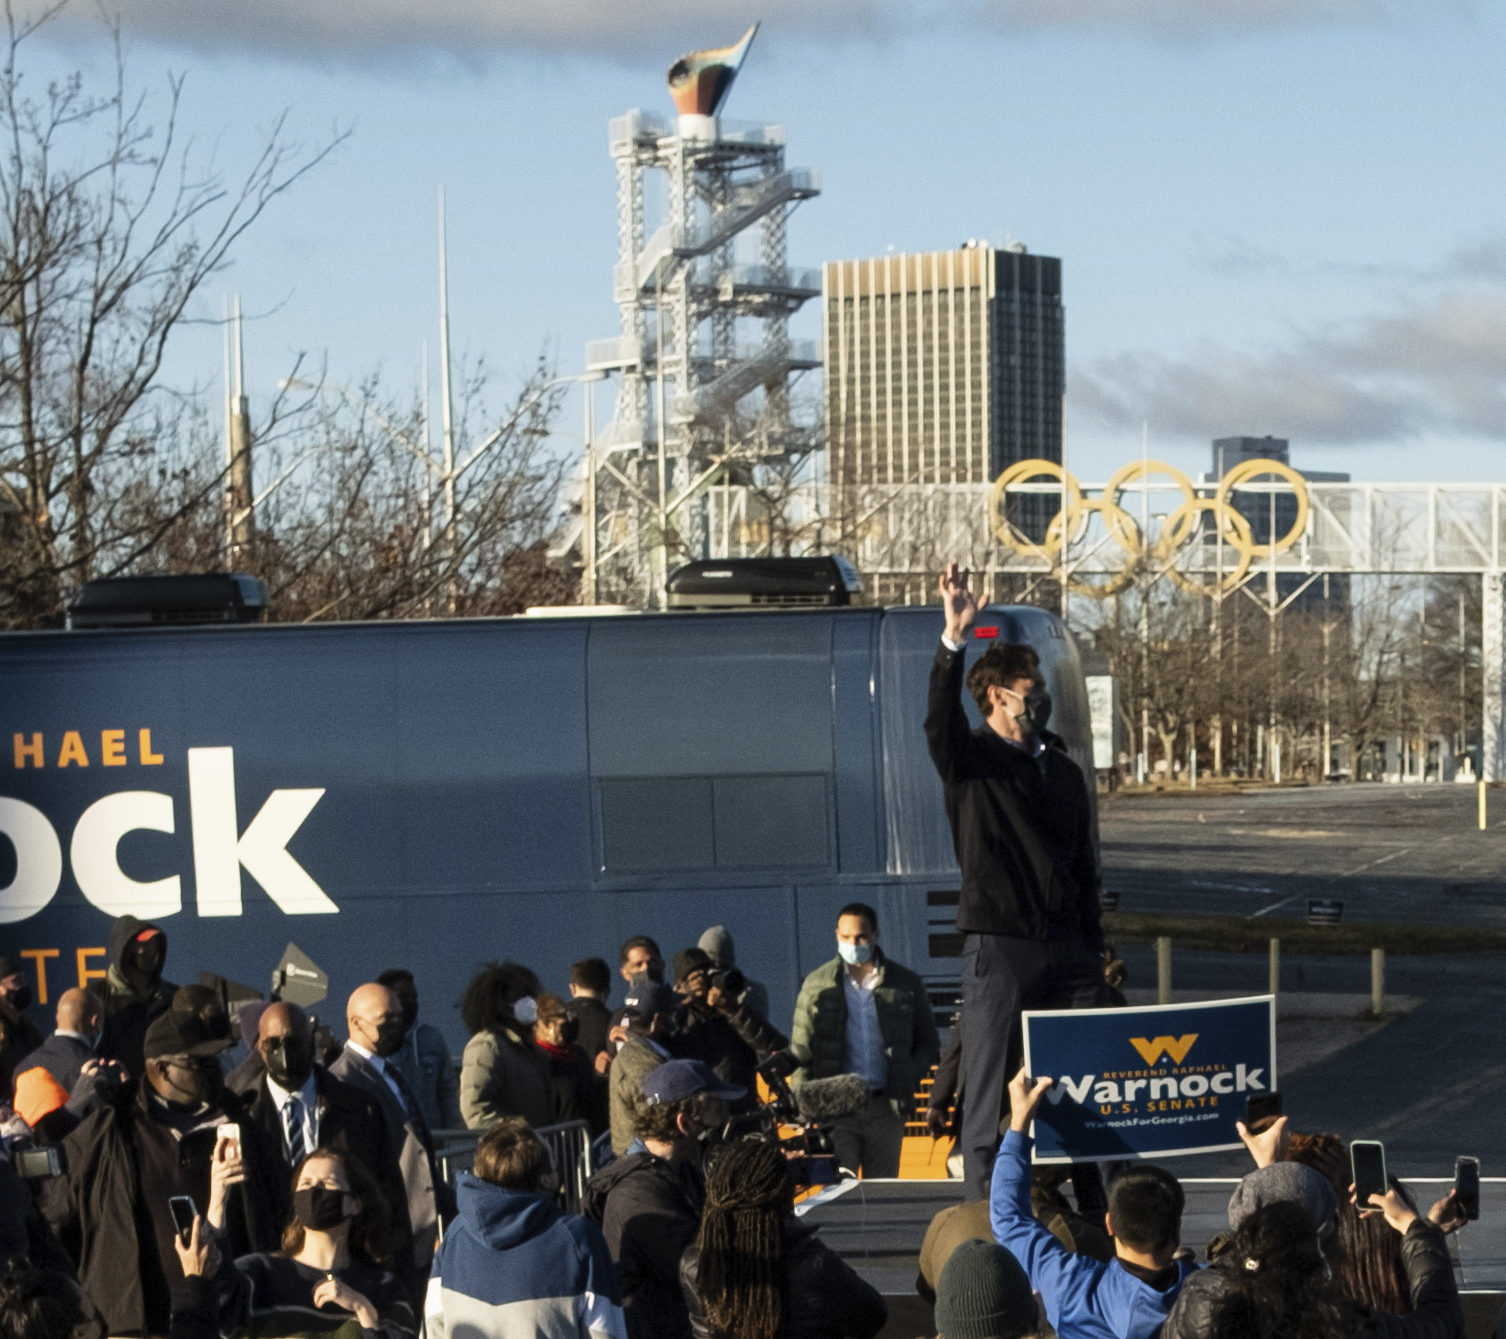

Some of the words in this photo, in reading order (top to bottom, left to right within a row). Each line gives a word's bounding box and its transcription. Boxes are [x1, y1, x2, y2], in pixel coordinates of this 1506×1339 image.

[1103, 1068, 1167, 1079] REVEREND
[1045, 1063, 1266, 1105] Warnock
[1147, 1096, 1219, 1113] SENATE
[1084, 1112, 1220, 1130] WarnockForGeorgia.com
